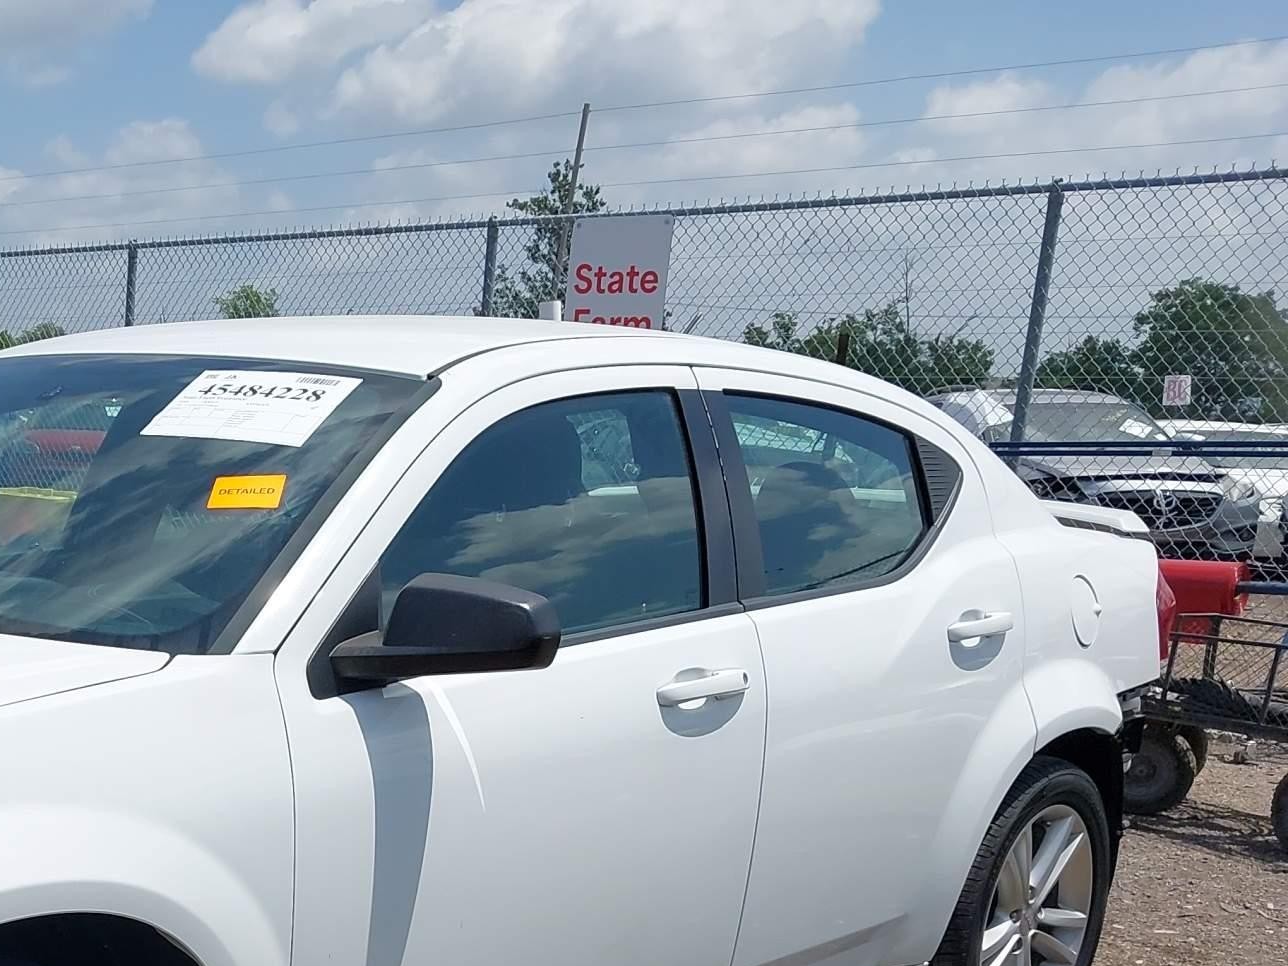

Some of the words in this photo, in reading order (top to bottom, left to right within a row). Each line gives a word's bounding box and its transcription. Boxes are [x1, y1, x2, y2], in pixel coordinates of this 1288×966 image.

[574, 263, 659, 295] State
[198, 383, 326, 402] 45484228
[218, 487, 276, 496] DETAILED
